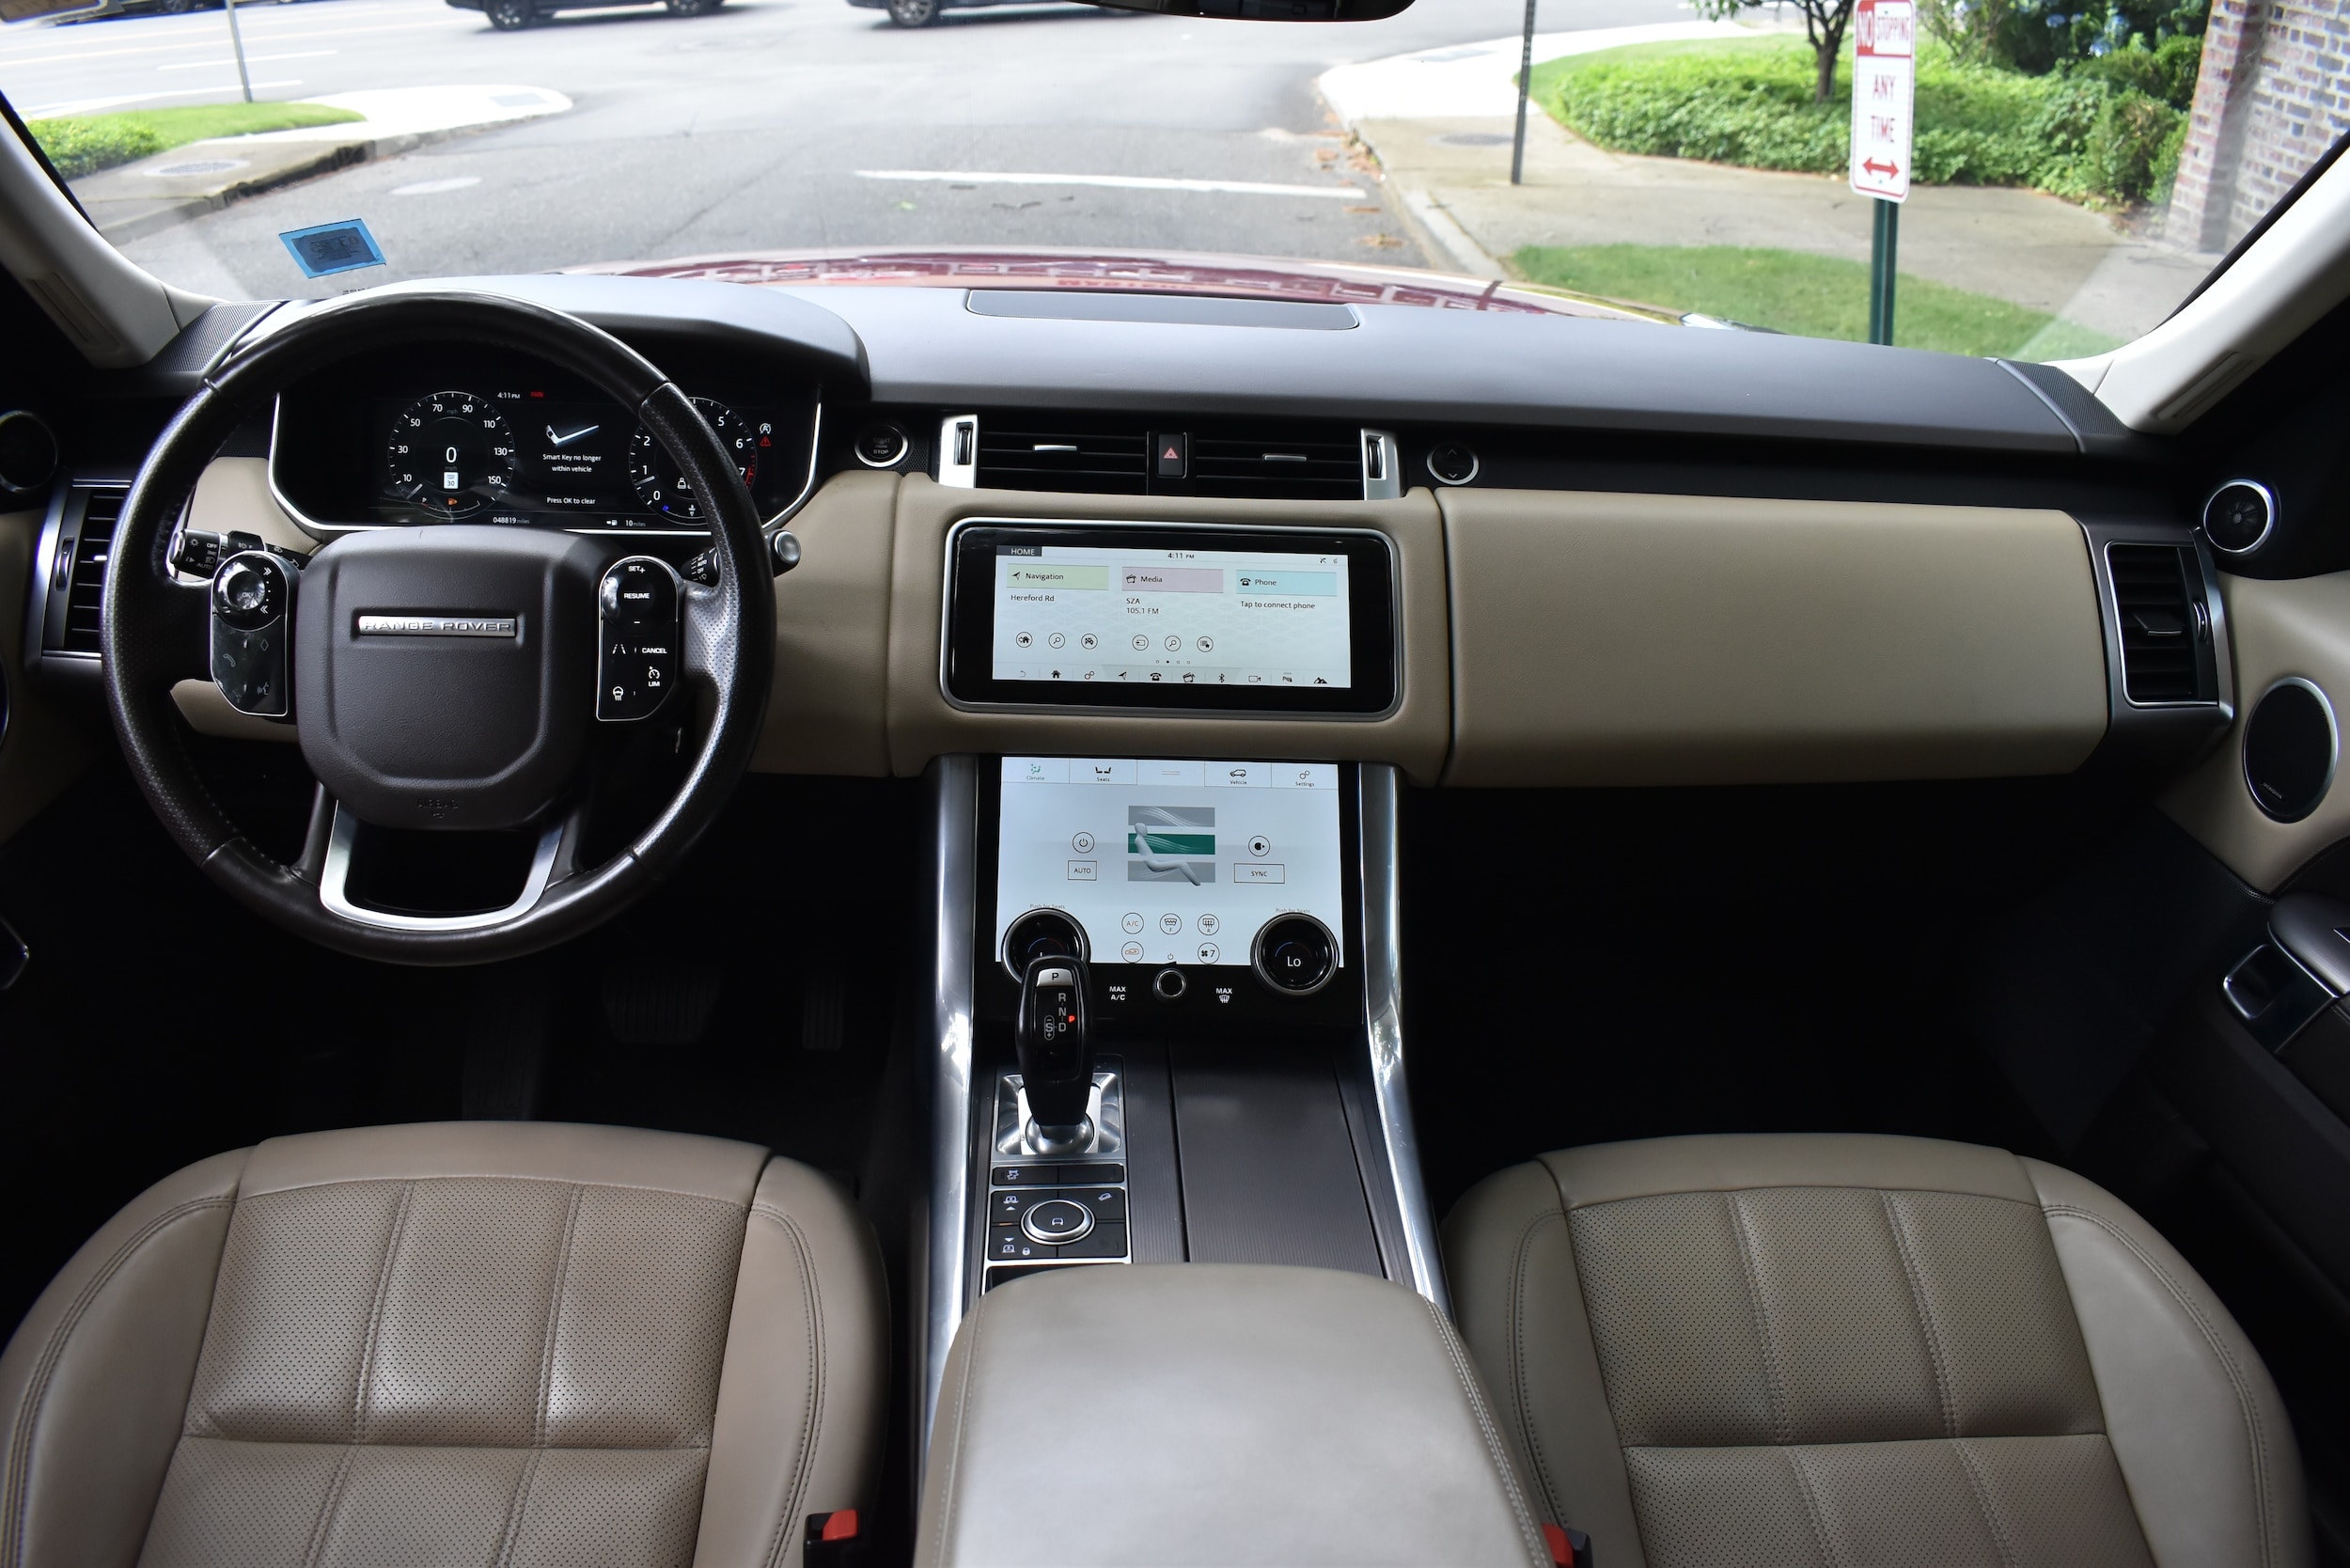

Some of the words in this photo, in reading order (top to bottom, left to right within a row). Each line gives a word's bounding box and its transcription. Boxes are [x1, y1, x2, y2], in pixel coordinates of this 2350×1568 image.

[1857, 10, 1874, 47] NO
[1877, 16, 1910, 41] STOPPING
[1872, 74, 1896, 101] ANY
[1871, 115, 1895, 143] TIME
[432, 404, 443, 413] 70
[462, 404, 473, 413] 90
[410, 418, 420, 427] 50
[483, 420, 495, 429] 110
[718, 417, 725, 427] 5
[643, 437, 650, 447] 2
[735, 439, 744, 448] 6
[398, 446, 408, 454] 30
[494, 447, 508, 456] 130
[446, 447, 458, 463] 0
[561, 454, 573, 463] Key
[582, 454, 602, 463] longer
[642, 465, 649, 475] 1
[739, 467, 746, 477] 7
[403, 474, 412, 482] 10
[488, 476, 502, 485] 150
[652, 491, 661, 501] 0
[196, 562, 213, 571] AUTO
[1026, 572, 1064, 581] Navigation
[1241, 601, 1253, 609] Tap
[365, 621, 433, 631] RANGE
[441, 621, 511, 632] ROVER
[1210, 949, 1215, 958] 7
[1287, 956, 1302, 967] Lo
[1052, 972, 1059, 980] P
[1058, 993, 1066, 1002] R
[1058, 1008, 1067, 1016] N
[1045, 1023, 1053, 1032] S
[1058, 1023, 1066, 1032] D
